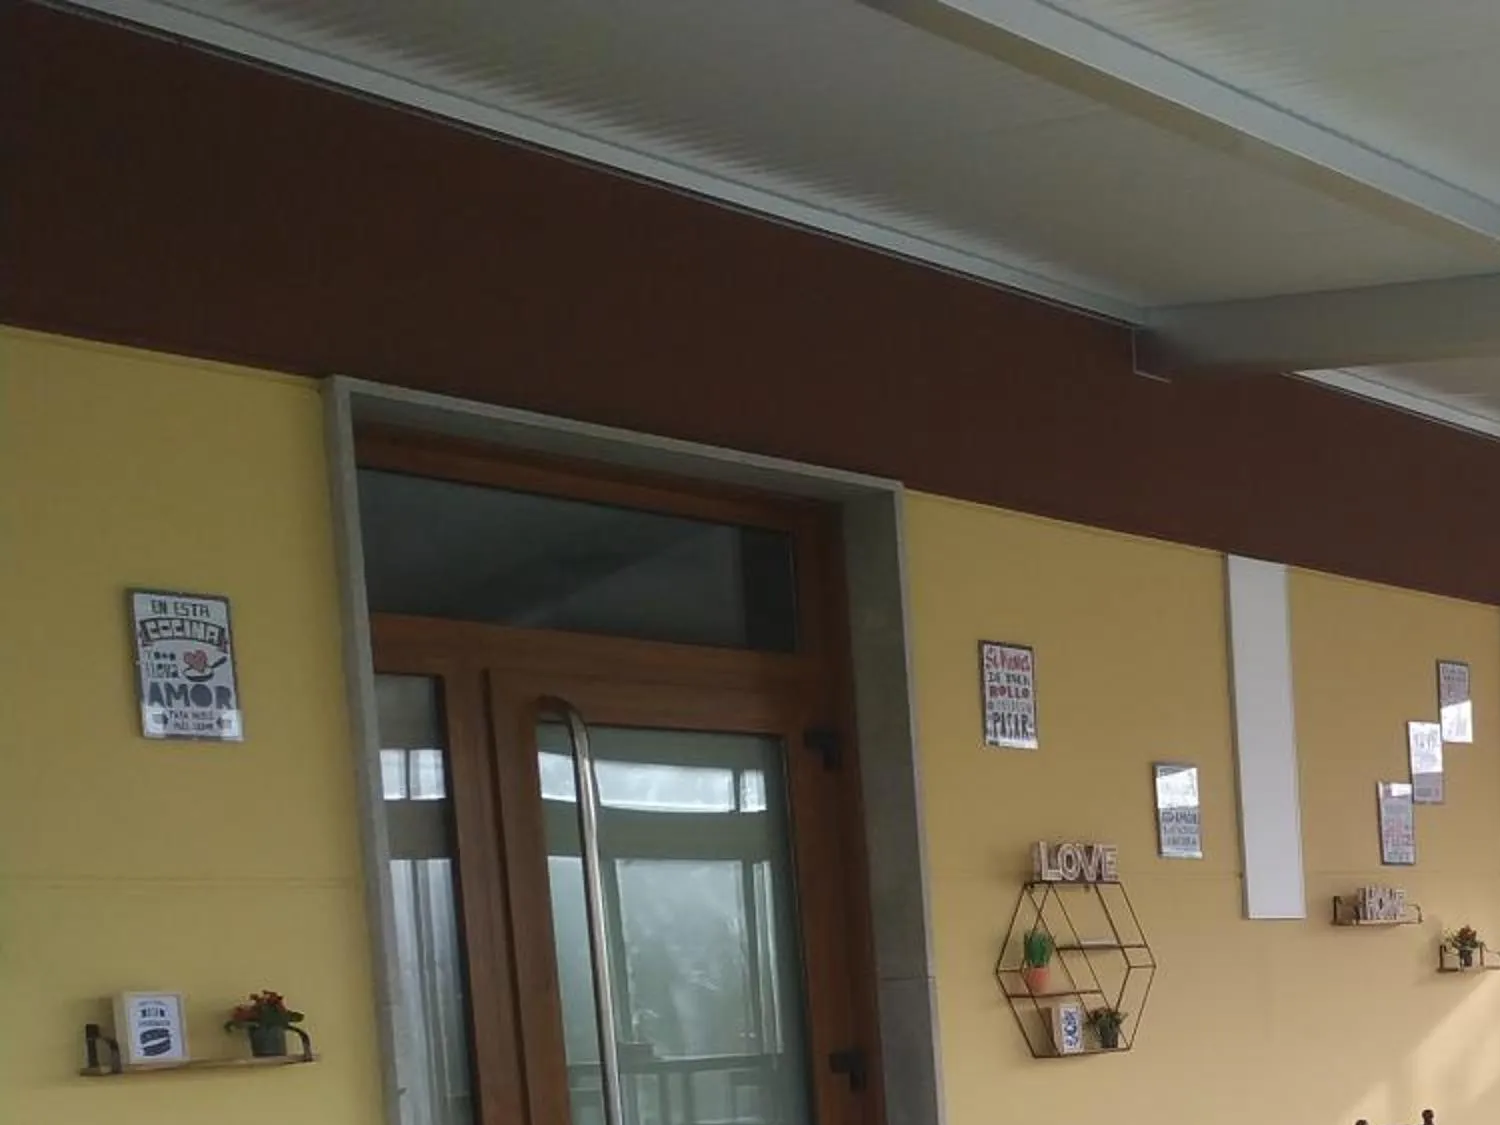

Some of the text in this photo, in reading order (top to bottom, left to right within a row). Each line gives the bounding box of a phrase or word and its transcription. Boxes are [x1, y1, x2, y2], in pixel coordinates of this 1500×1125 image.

[145, 619, 220, 645] COCINA
[148, 681, 232, 709] AMOR
[1037, 840, 1119, 883] LOVE
